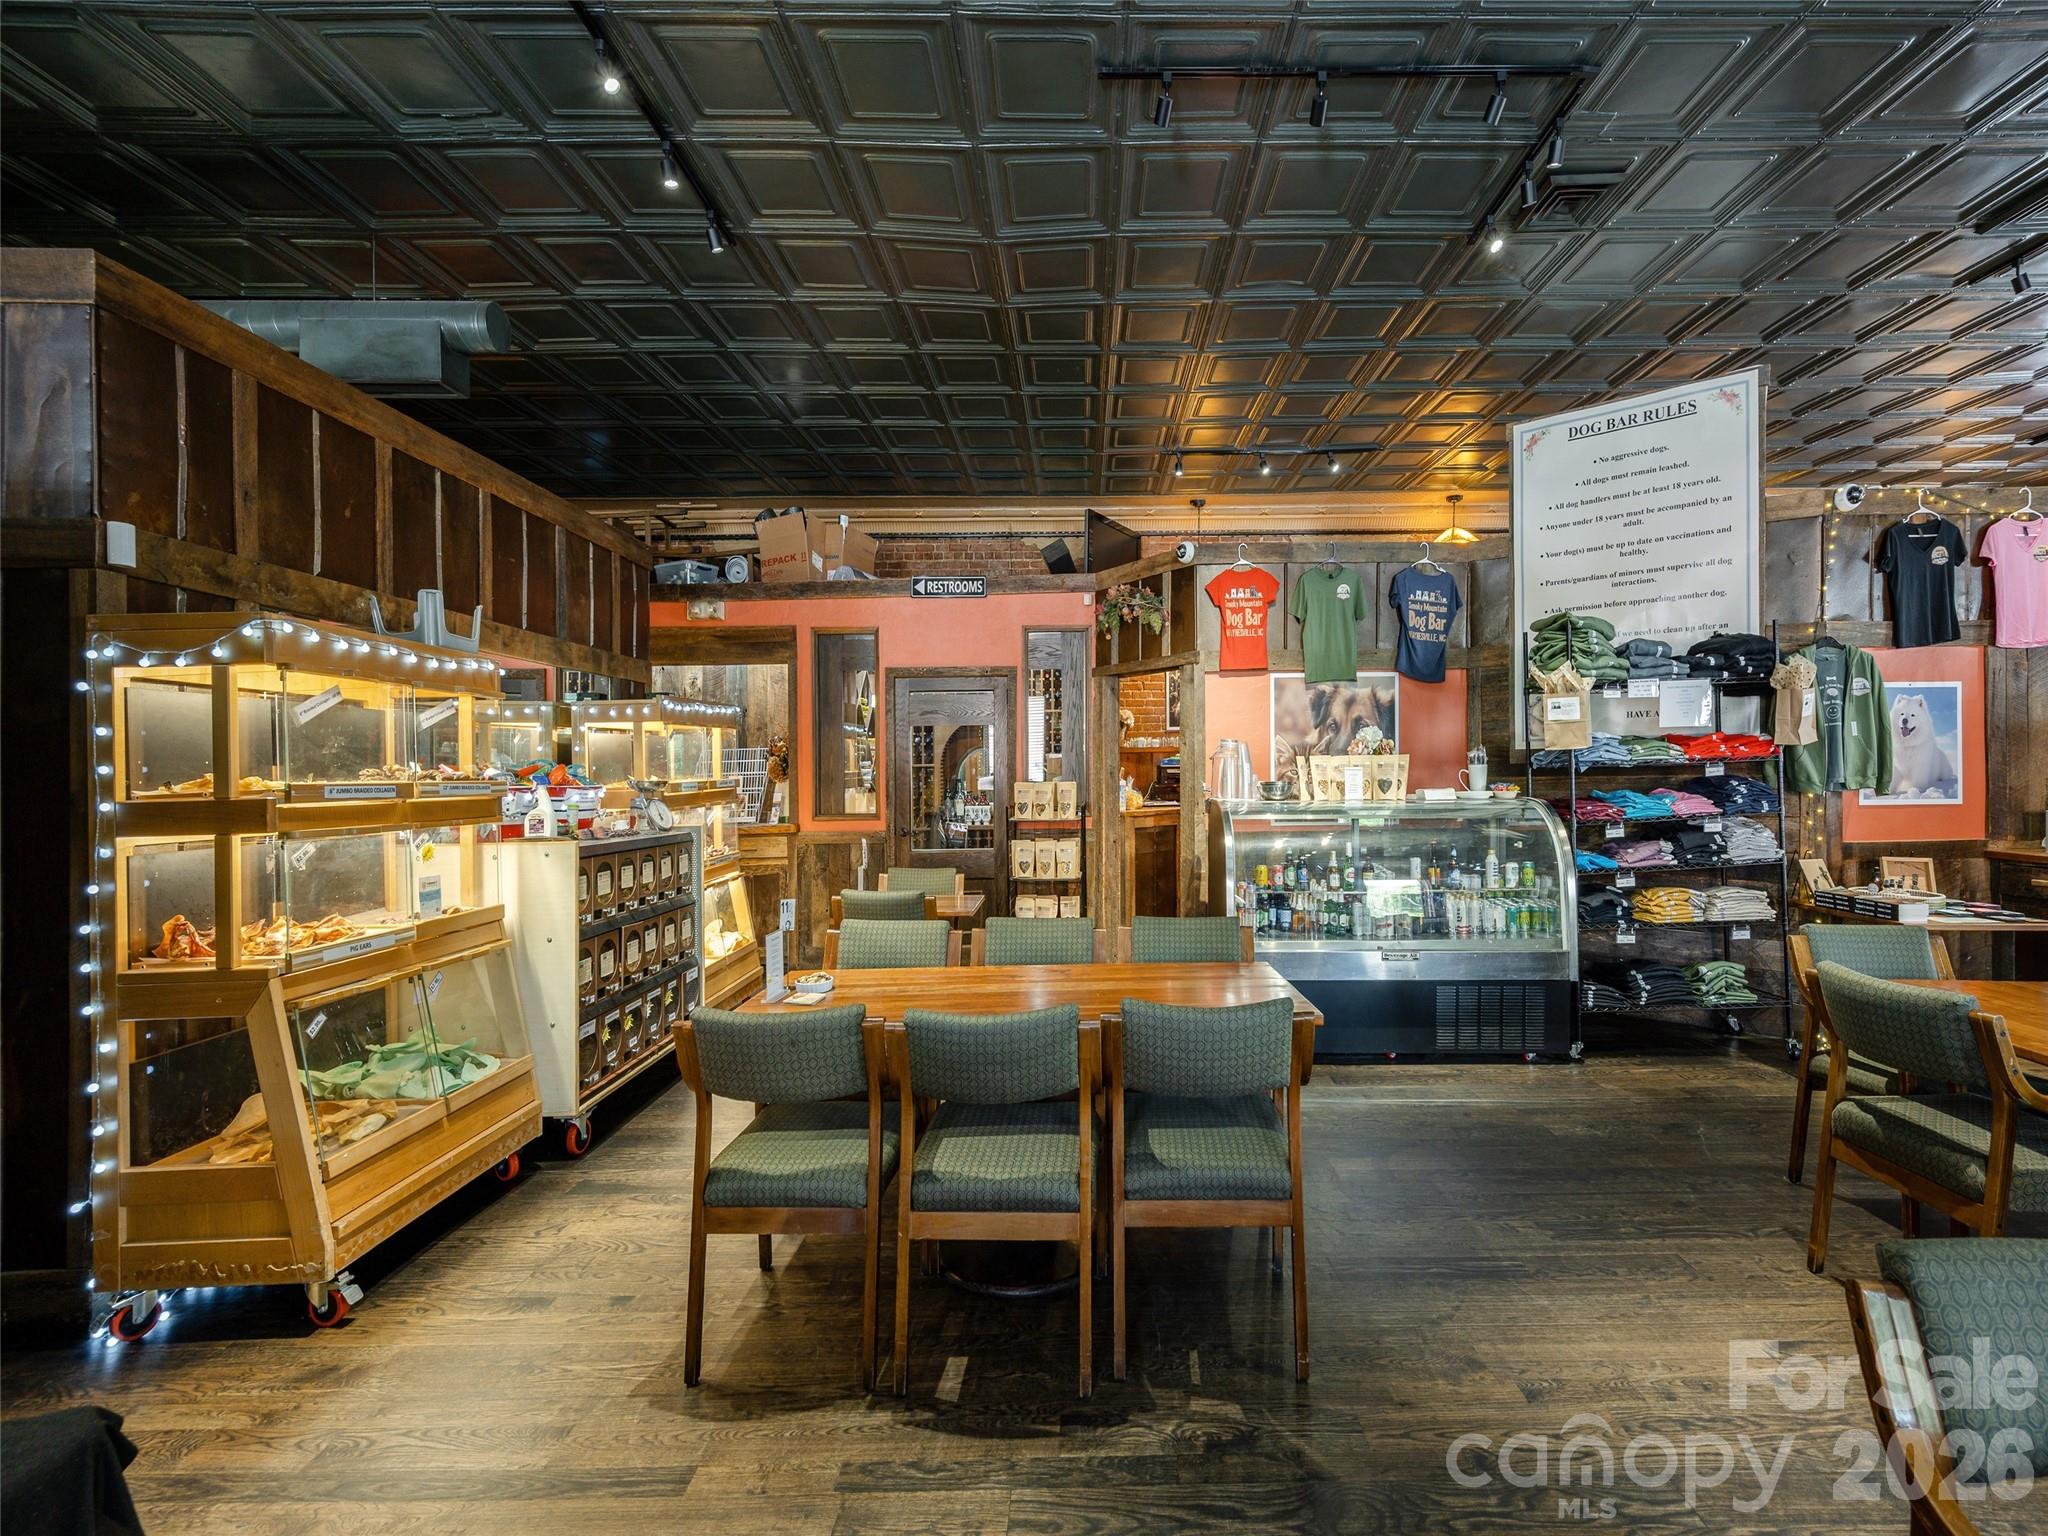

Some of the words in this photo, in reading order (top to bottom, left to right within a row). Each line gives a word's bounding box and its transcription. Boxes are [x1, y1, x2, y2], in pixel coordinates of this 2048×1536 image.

[1568, 421, 1601, 439] DOG
[1606, 413, 1639, 430] BAR
[1643, 400, 1697, 422] RULES
[1599, 456, 1609, 464] No
[1611, 449, 1648, 462] aggressive
[1649, 444, 1670, 456] dogs.
[1580, 479, 1591, 487] All
[1593, 476, 1609, 486] dogs
[1611, 472, 1629, 481] must
[1630, 467, 1657, 477] remain
[1659, 460, 1690, 472] leashed.
[1554, 503, 1565, 511] All
[1566, 501, 1579, 511] dog
[1580, 496, 1611, 506] handlers
[1612, 492, 1630, 501] must
[1632, 489, 1641, 497] be
[1643, 487, 1651, 495] at
[1652, 484, 1670, 494] least
[1672, 482, 1681, 490] 18
[1682, 480, 1704, 491] years
[1706, 475, 1721, 484] old.
[1545, 522, 1571, 532] Anyone
[1572, 517, 1593, 527] under
[1595, 515, 1603, 523] 18
[1604, 513, 1624, 523] years
[1626, 509, 1644, 518] must
[1657, 498, 1708, 513] accompanied
[1710, 496, 1720, 506] by
[1722, 494, 1733, 502] an
[1622, 519, 1645, 528] adult.
[1545, 551, 1562, 559] Your
[1563, 547, 1585, 558] dog(s)
[1586, 544, 1604, 553] must
[1616, 542, 1626, 551] up
[1627, 539, 1635, 547] to
[1636, 537, 1653, 546] date
[1654, 535, 1664, 543] on
[1666, 528, 1715, 541] vaccinations
[1716, 525, 1732, 534] and
[761, 553, 797, 568] REPACK
[1619, 549, 1649, 560] healthy.
[1545, 573, 1608, 588] Parents/guardians
[1609, 571, 1618, 579] of
[1618, 568, 1645, 578] minors
[1646, 565, 1665, 574] must
[1667, 561, 1704, 574] supervise
[1705, 558, 1716, 567] all
[1717, 557, 1733, 568] dog
[927, 580, 983, 593] RESTROOMS
[1611, 577, 1657, 588] interactions.
[1239, 599, 1264, 608] Mountain
[1423, 602, 1448, 613] Mountain
[1550, 606, 1564, 614] Ask
[1564, 603, 1602, 613] permission
[1603, 599, 1627, 608] before
[1628, 594, 1677, 607] approaching
[1677, 590, 1709, 600] another
[1710, 589, 1728, 599] dog.
[1226, 608, 1243, 629] Dog
[1244, 607, 1263, 626] Bar
[1408, 610, 1427, 632] Dog
[1428, 612, 1447, 631] Bar
[1633, 628, 1652, 637] need
[1663, 624, 1683, 634] clean
[1684, 624, 1696, 635] up
[1697, 622, 1716, 631] after
[1718, 622, 1729, 630] an
[1626, 709, 1652, 719] HAVE
[336, 787, 354, 795] JUMBO
[354, 787, 373, 795] BRAIDED
[350, 944, 359, 953] PIG
[359, 941, 372, 951] EARS
